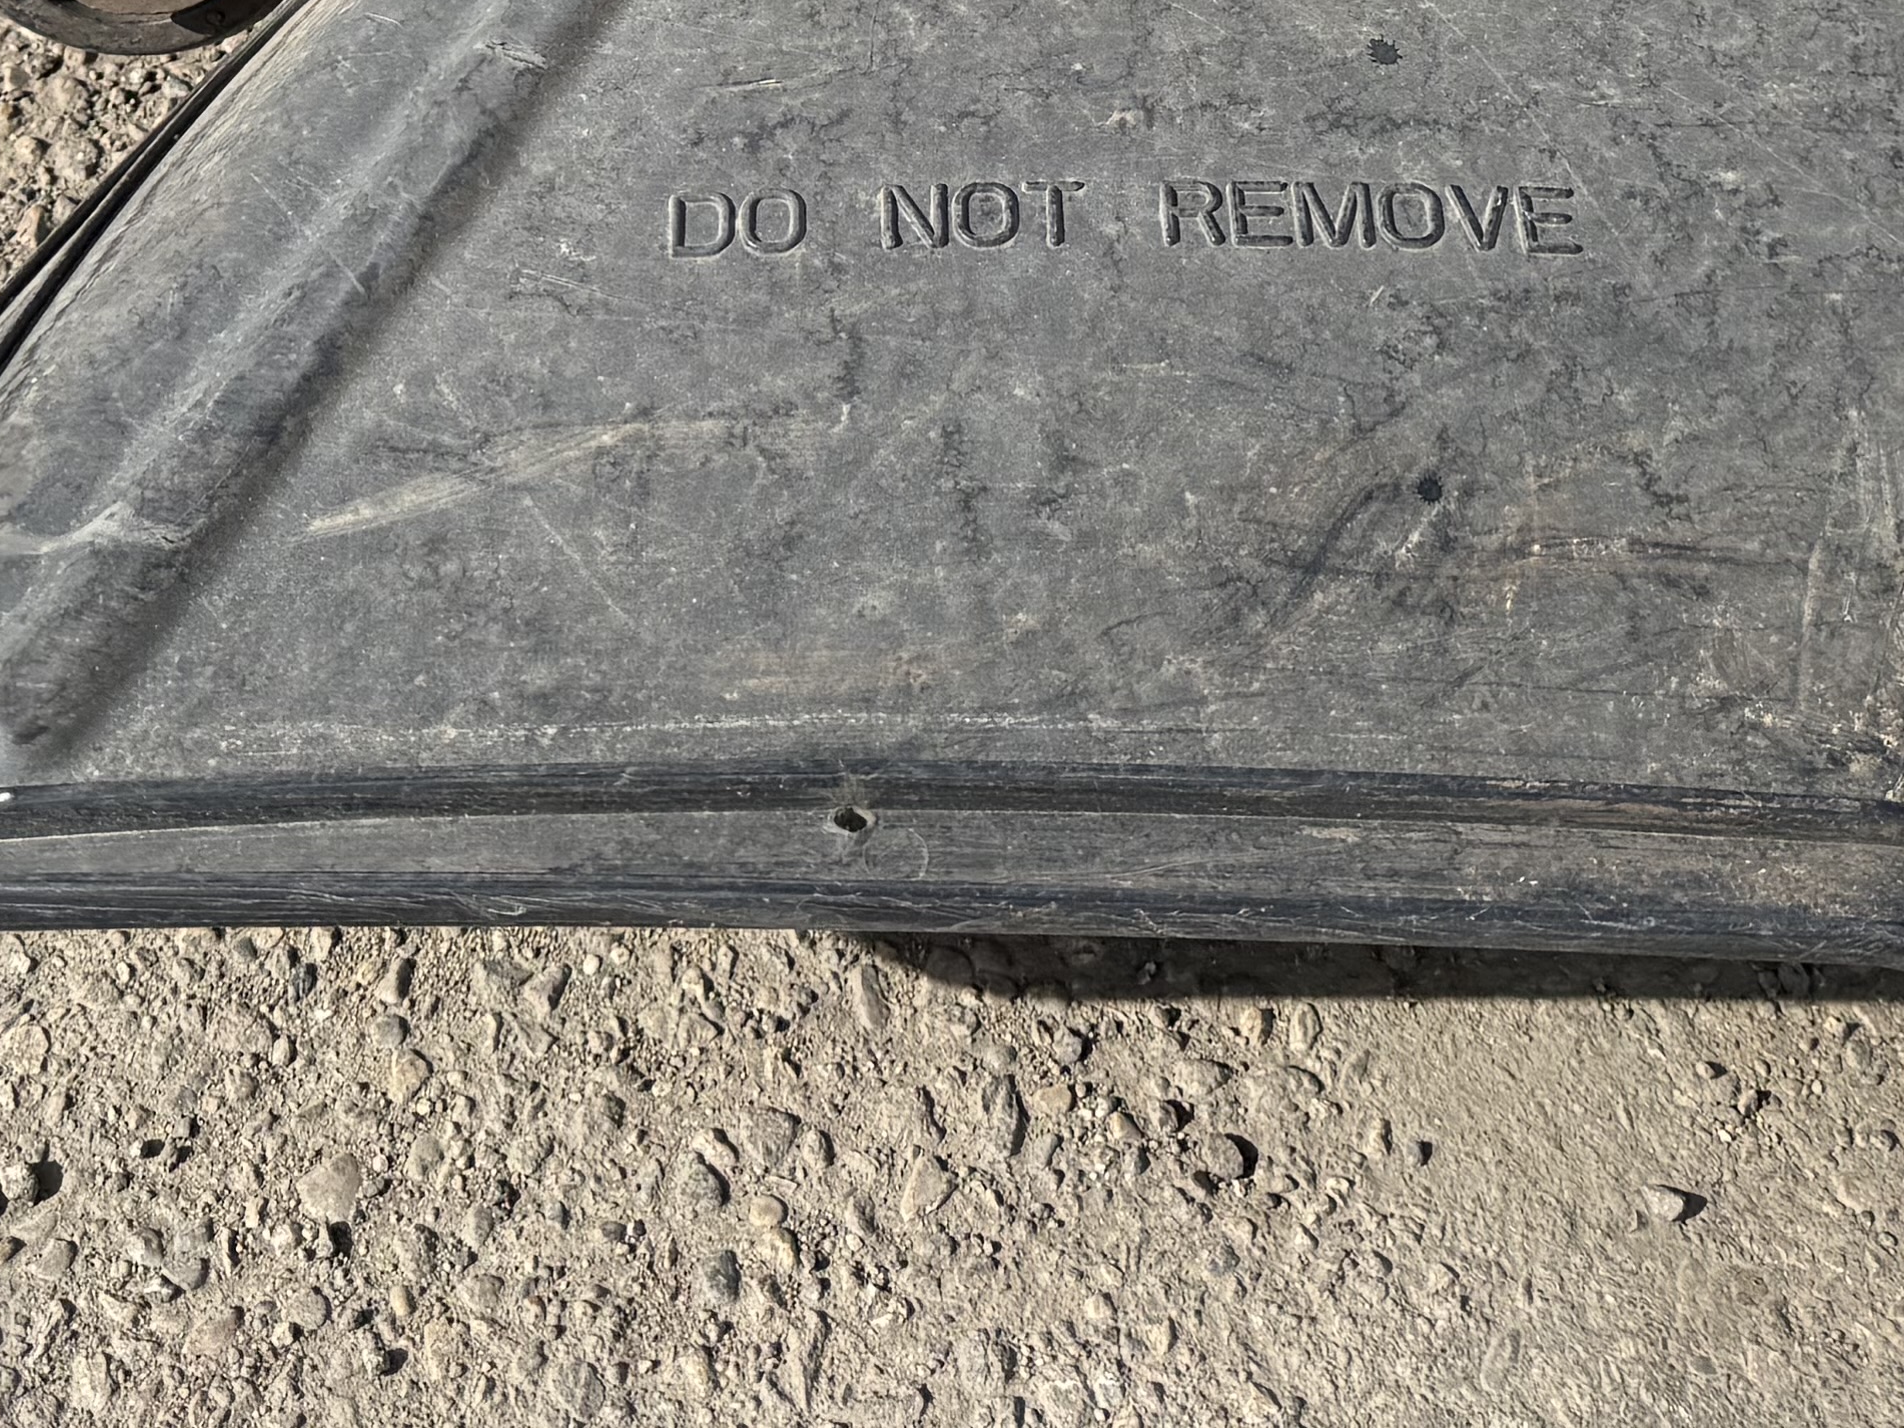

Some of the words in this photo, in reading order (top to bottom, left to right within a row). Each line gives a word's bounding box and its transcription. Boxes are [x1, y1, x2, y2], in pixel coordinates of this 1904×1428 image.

[668, 187, 806, 257] DO
[881, 181, 1084, 249] NOT
[1160, 181, 1584, 255] REMOVE
